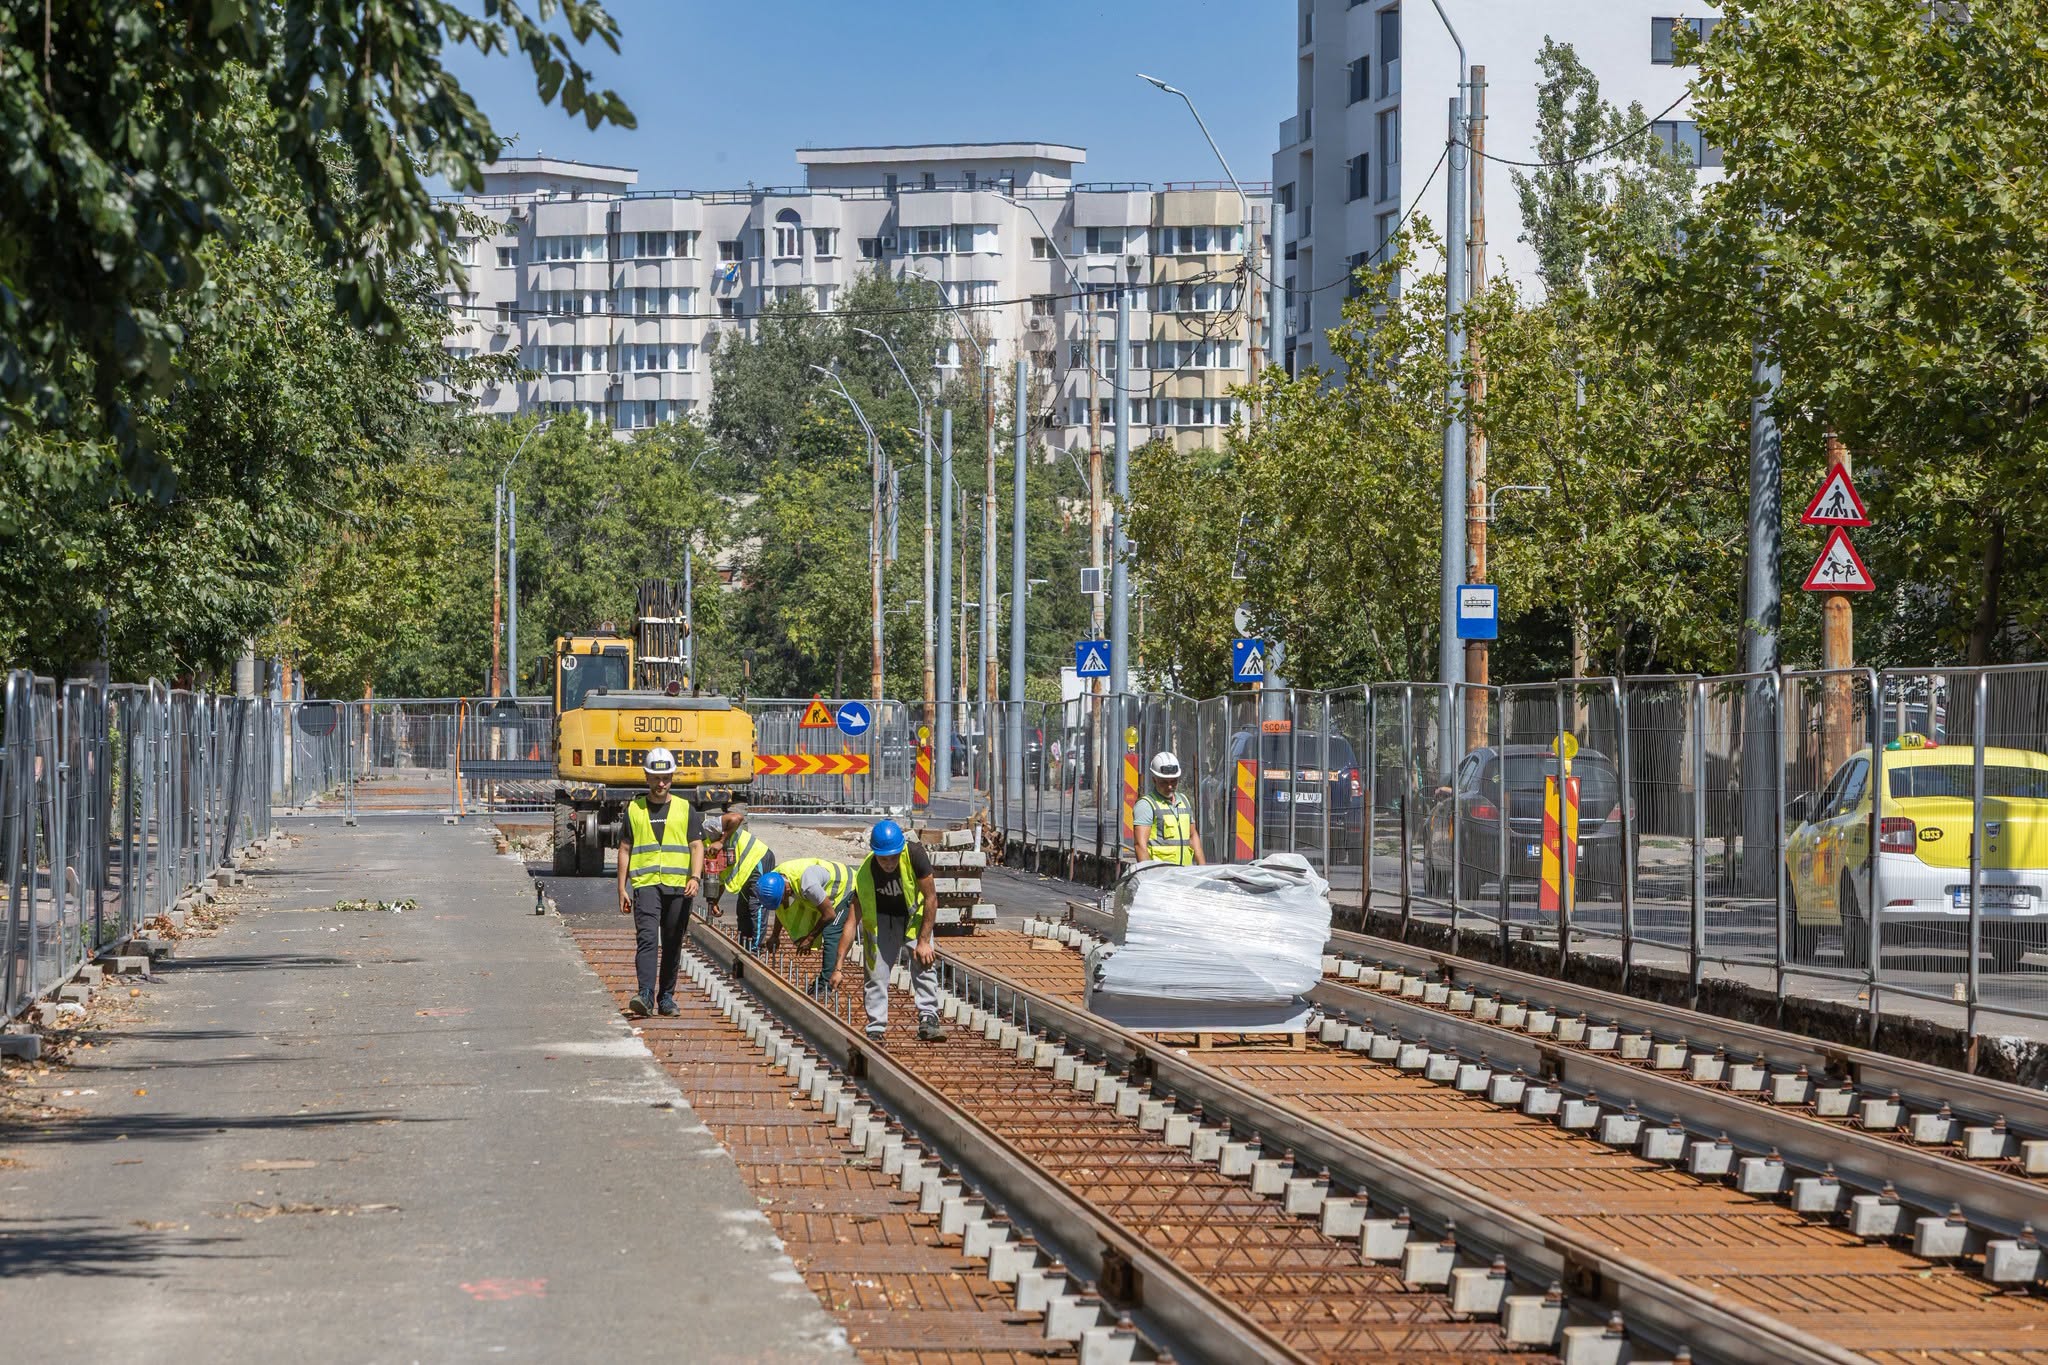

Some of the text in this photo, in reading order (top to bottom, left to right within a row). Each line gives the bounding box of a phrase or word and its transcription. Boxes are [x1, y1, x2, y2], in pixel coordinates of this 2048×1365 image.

[634, 716, 682, 733] 900
[1903, 735, 1920, 747] TAXI
[595, 749, 719, 767] LIEBERR
[1921, 830, 1941, 840] 1933
